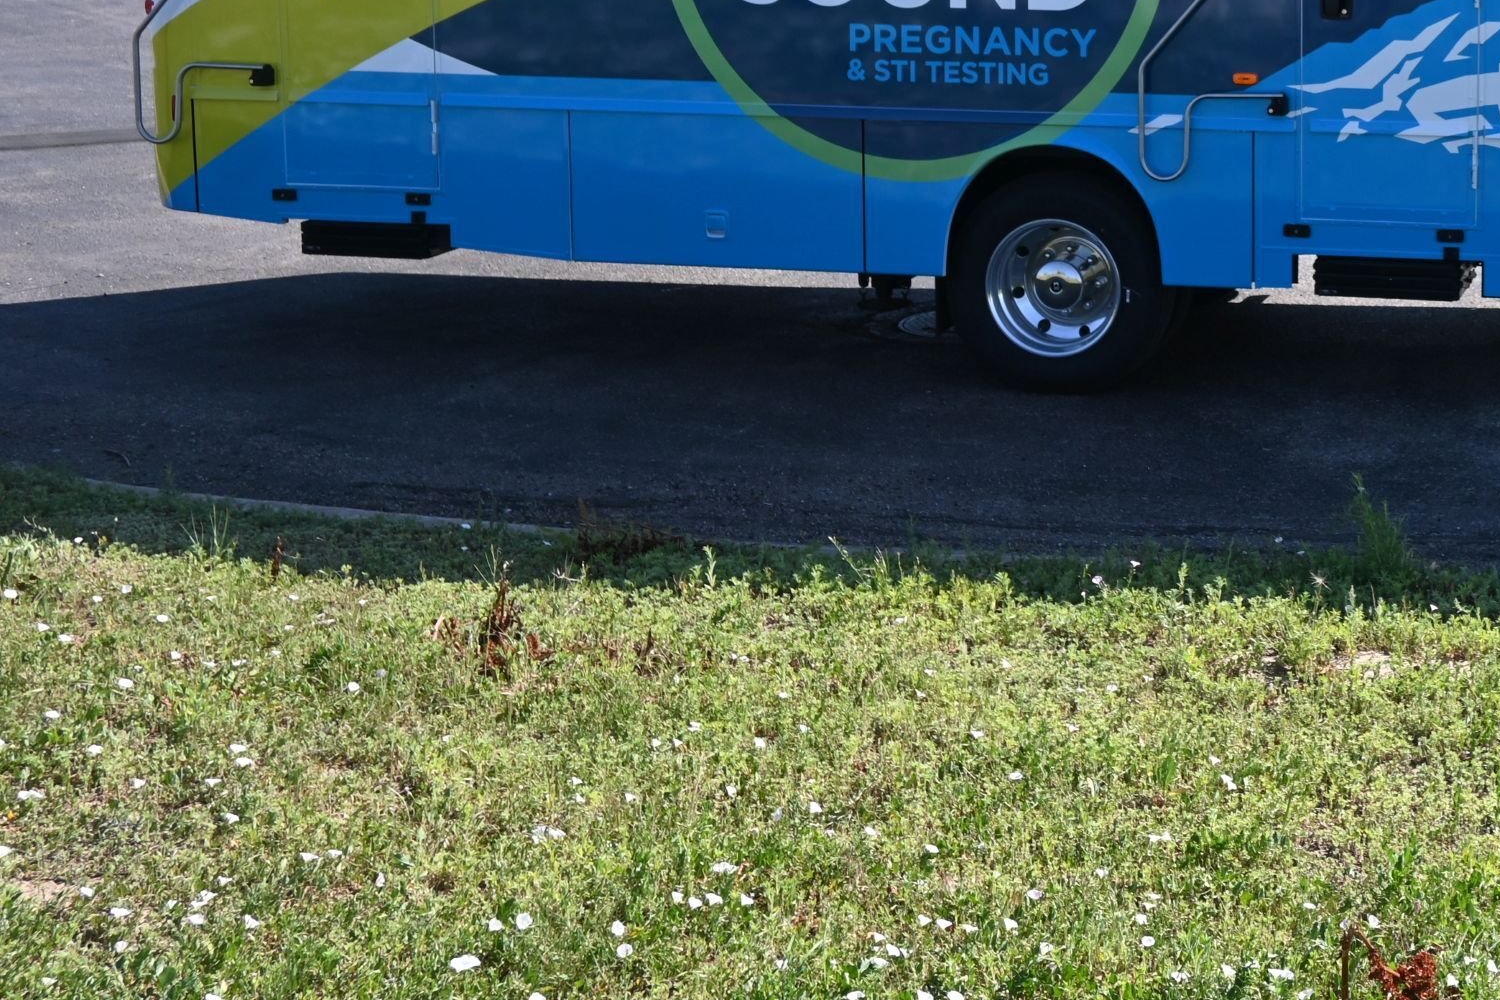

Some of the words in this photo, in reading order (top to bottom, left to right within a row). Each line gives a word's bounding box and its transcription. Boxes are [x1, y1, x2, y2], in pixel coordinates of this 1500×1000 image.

[848, 22, 1097, 58] PREGNANCY
[846, 58, 866, 81] &
[873, 58, 917, 83] STI
[924, 60, 1050, 87] TESTING
